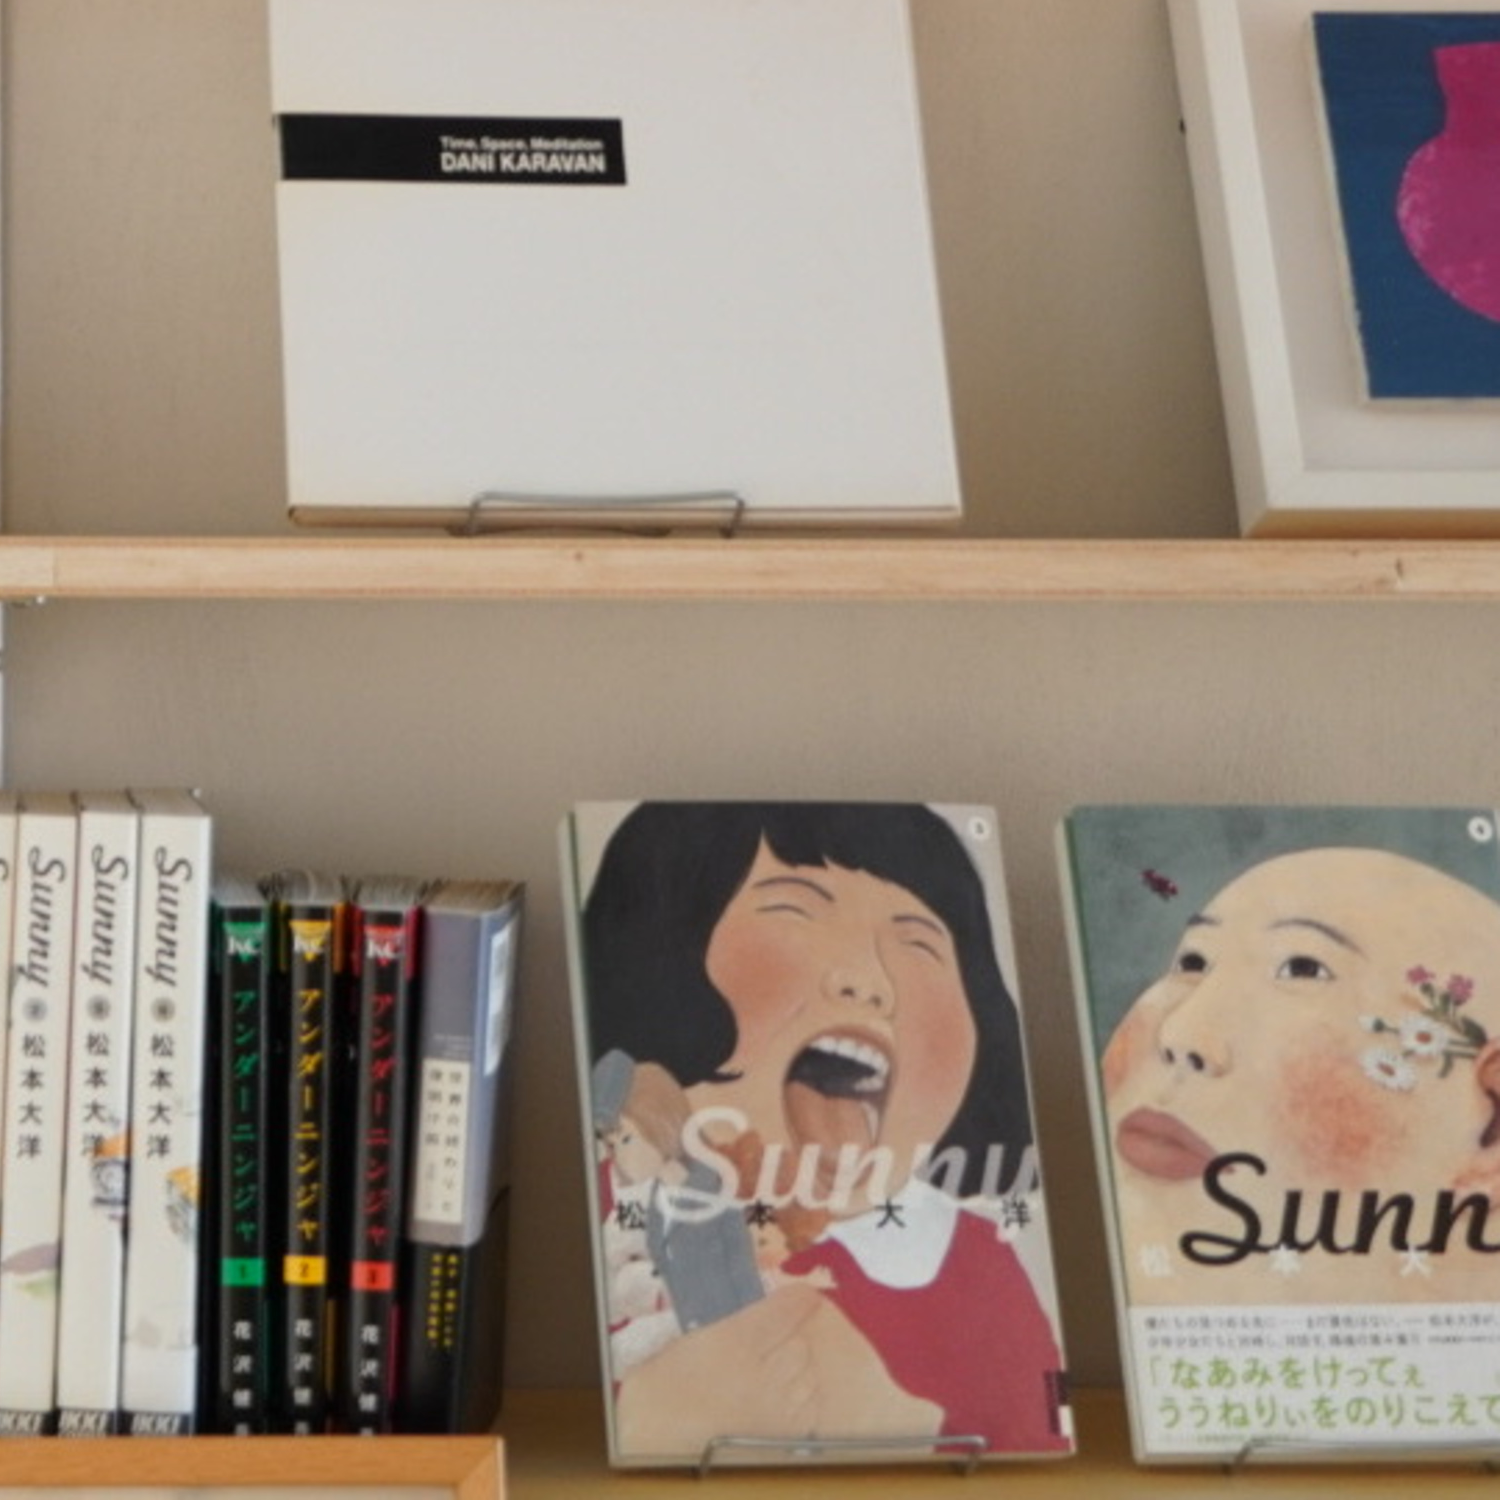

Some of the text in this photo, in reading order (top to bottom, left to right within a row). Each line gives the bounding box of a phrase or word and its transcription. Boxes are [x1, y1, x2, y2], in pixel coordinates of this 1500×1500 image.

[439, 135, 604, 153] Time, Space, Meditation
[440, 152, 607, 175] DANI KARAVAN
[16, 845, 66, 988] Sunny
[80, 844, 129, 987] Sunny
[144, 845, 193, 988] Sunny
[17, 1033, 47, 1159] 松本大洋
[80, 1032, 110, 1159] 松本大洋
[146, 1032, 176, 1159] 松本大洋
[230, 988, 259, 1243] アンダーニンジャ
[295, 987, 322, 1241] アンダーニンジャ
[366, 993, 394, 1247] アンダーニンジャ
[614, 1197, 1032, 1232] 松本大洋
[1152, 1355, 1425, 1389] 「なあみをけってぇ
